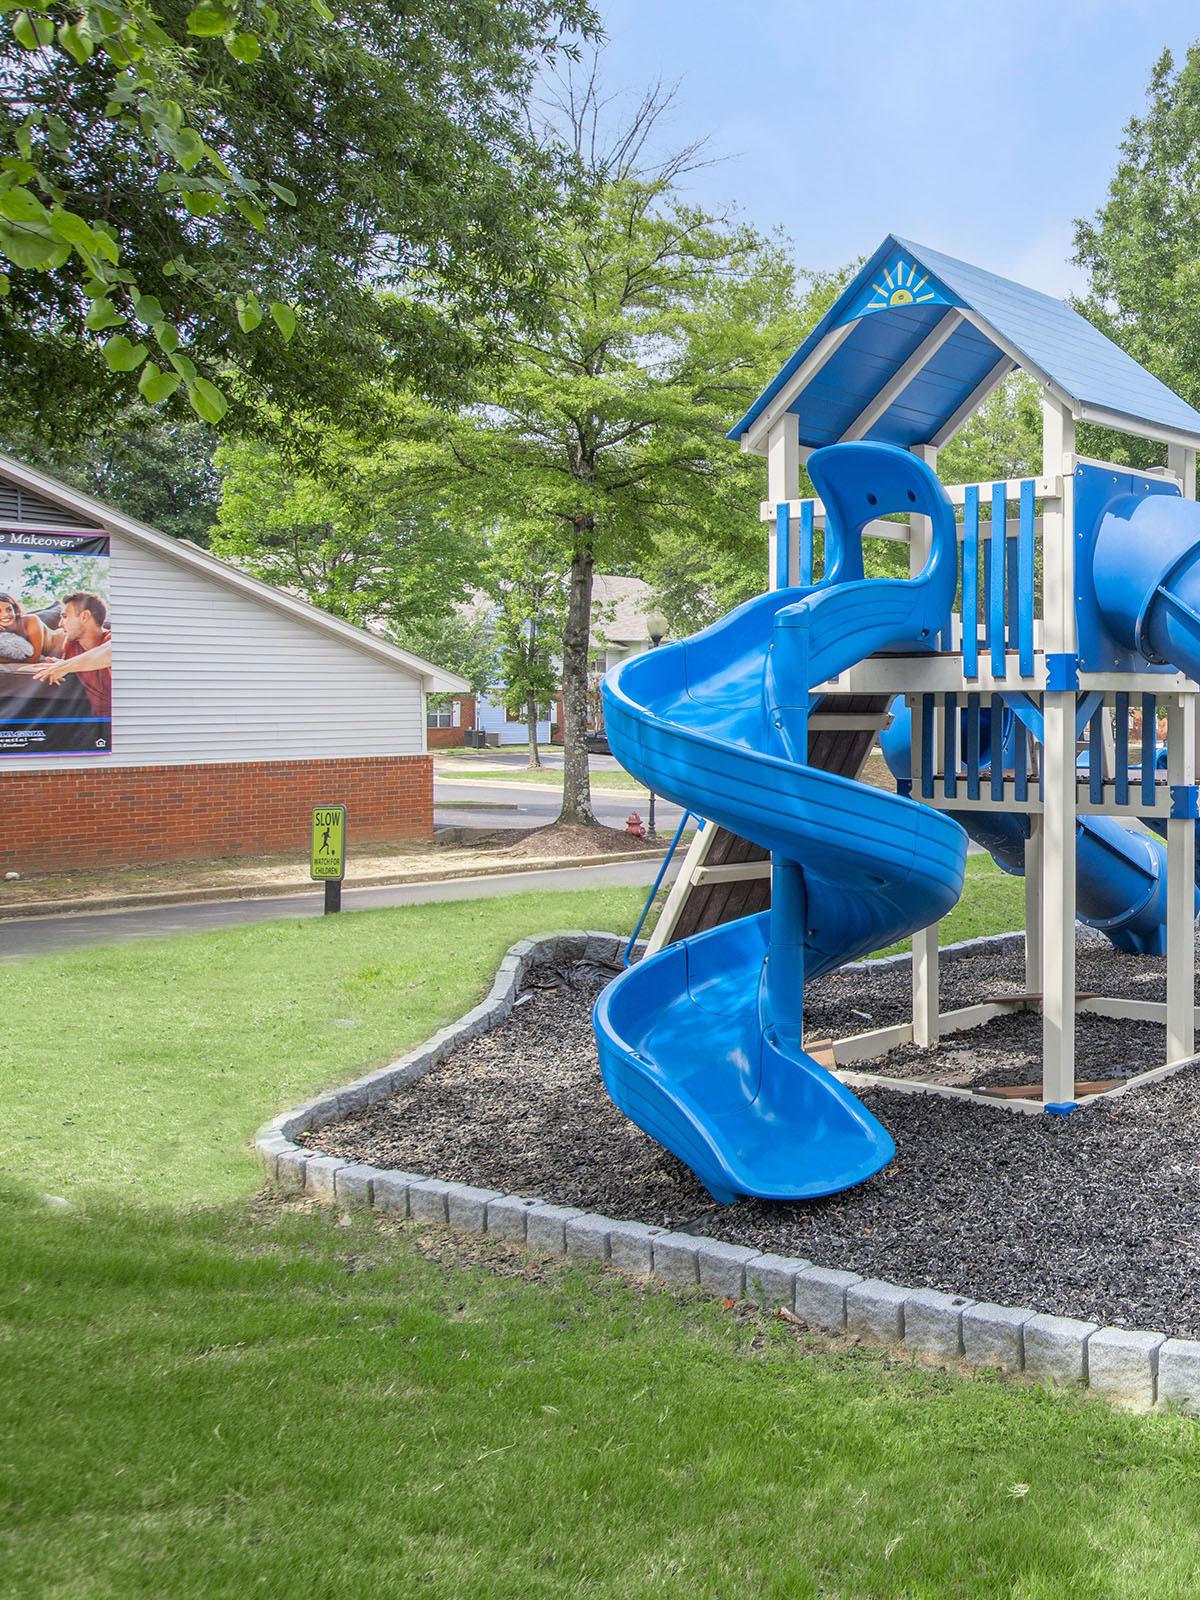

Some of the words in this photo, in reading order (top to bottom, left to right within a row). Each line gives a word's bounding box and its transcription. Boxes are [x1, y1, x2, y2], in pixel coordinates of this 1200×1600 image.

[316, 812, 340, 826] SLOW
[314, 858, 330, 866] WATCH
[331, 858, 340, 866] FOR
[315, 867, 338, 875] CHILDREN
